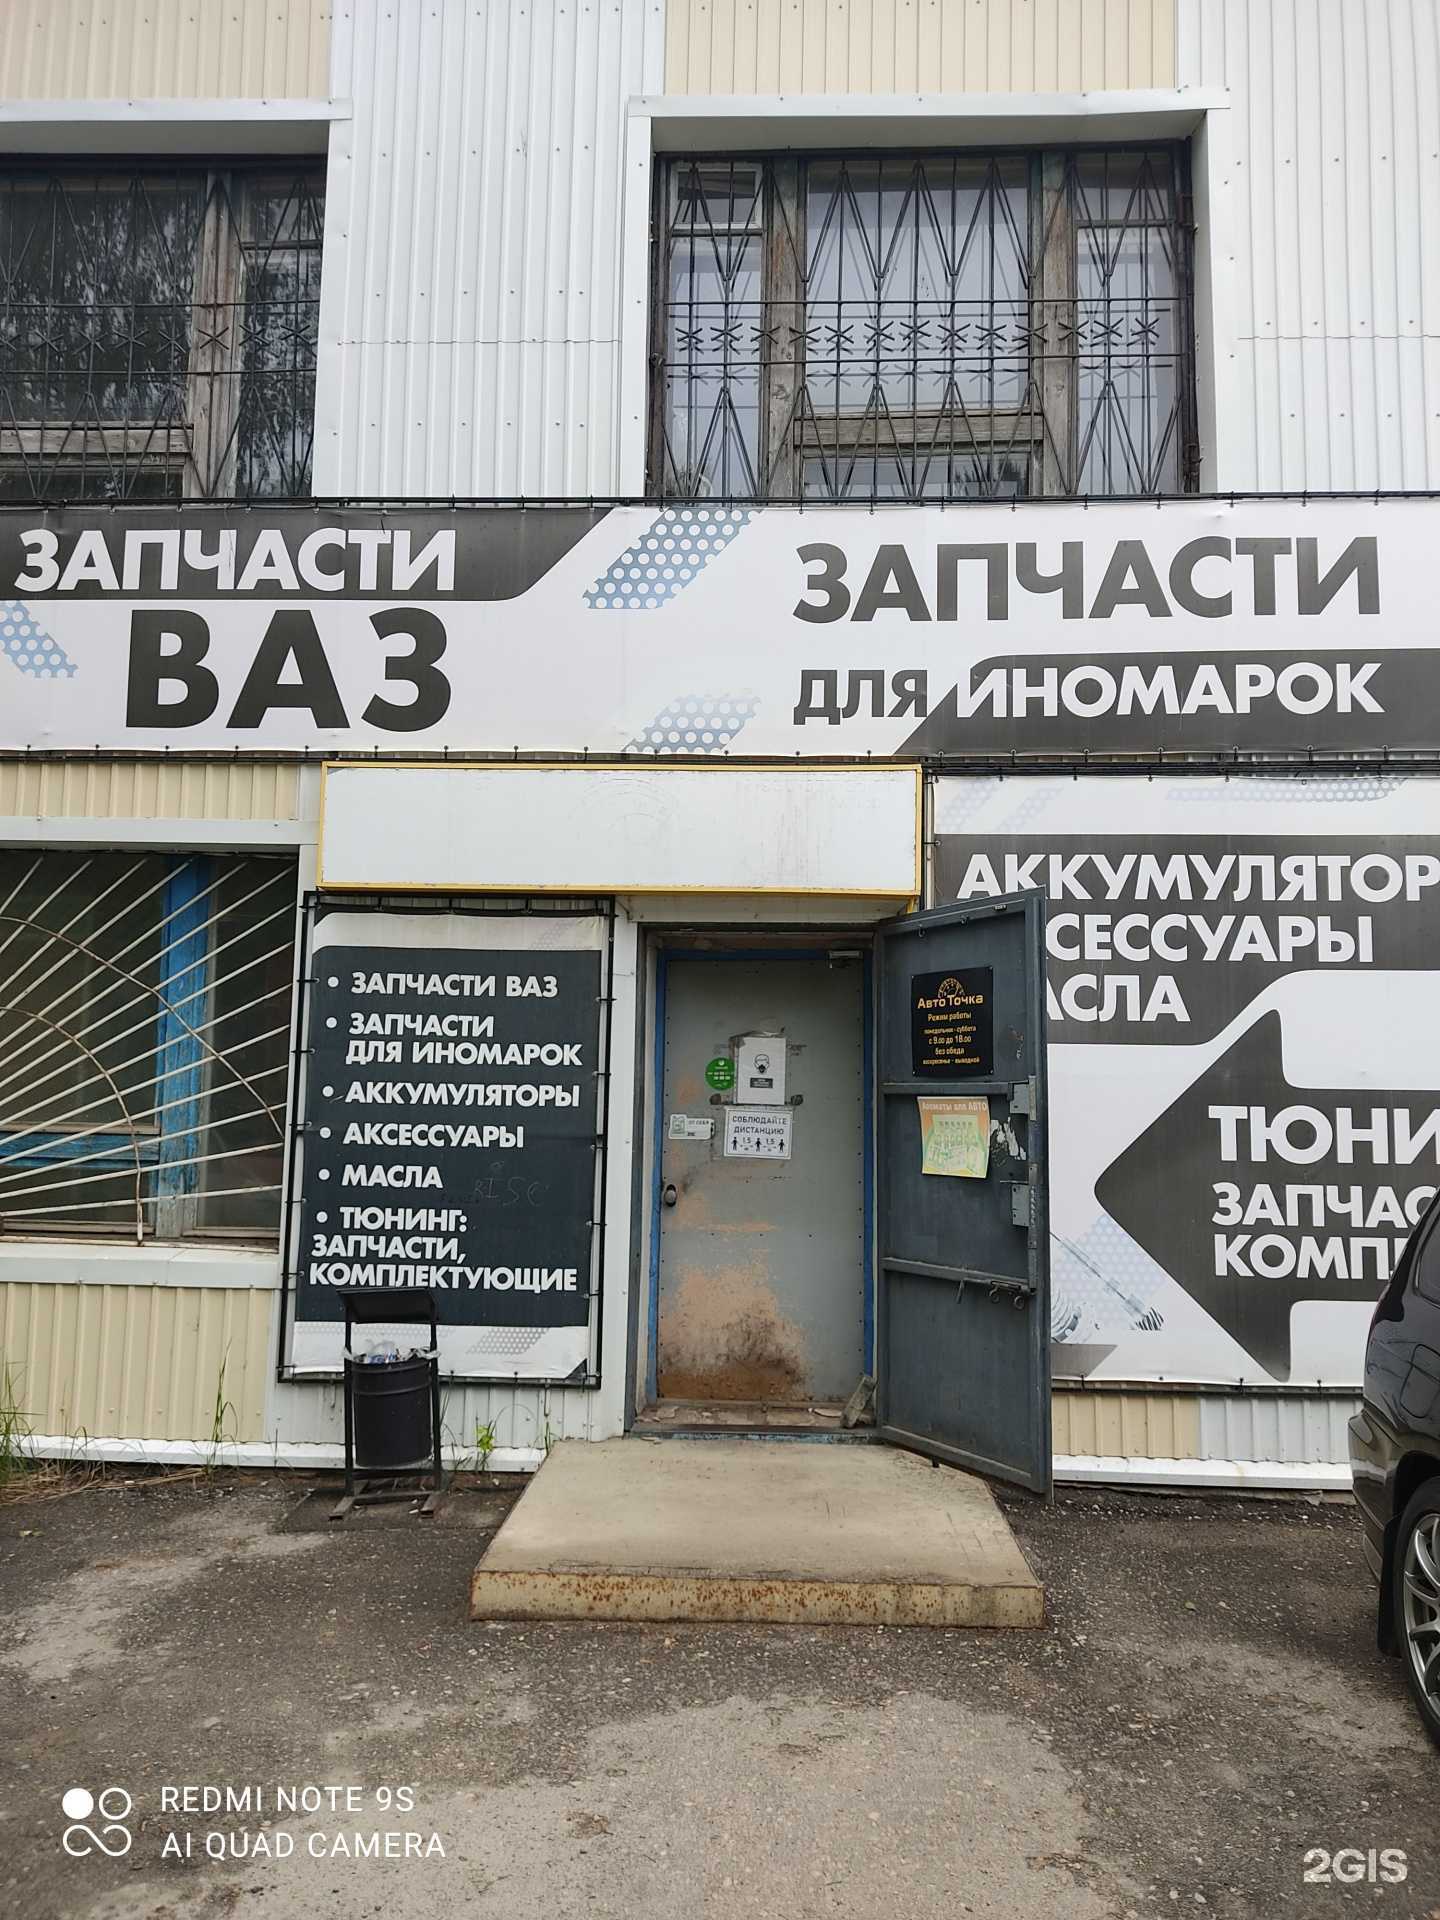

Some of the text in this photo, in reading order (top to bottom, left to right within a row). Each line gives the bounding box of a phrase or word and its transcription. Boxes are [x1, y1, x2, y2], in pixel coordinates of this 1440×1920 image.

[14, 527, 456, 593] ЗАПЧАСТИ
[793, 536, 1380, 624] ЗАПЧАСТИ
[126, 607, 452, 732] ВАЗ
[793, 662, 1385, 725] ДЛЯ ИНОМАРОК
[957, 853, 1440, 902] АККУМУЛЯТОР
[1046, 913, 1373, 962] СЕССУАРЫ
[351, 972, 558, 998] ЗАПЧАСТИ ВАЗ
[349, 1013, 494, 1038] ЗАПЧАСТИ
[345, 1040, 583, 1067] ДЛЯ ИНОМАРОК
[345, 1082, 580, 1107] АККУМУЛЯТОРЫ
[732, 1115, 788, 1126] СОБЛЮДАЙТЕ
[733, 1126, 785, 1136] ДИСТАНЦИЮ
[343, 1122, 524, 1148] АКСЕССУАРЫ
[1208, 1105, 1440, 1166] ТЮНИ
[341, 1164, 443, 1189] МАСЛА
[340, 1206, 468, 1233] ТЮНИНГ:
[312, 1234, 466, 1264] ЗАПЧАСТИ,
[310, 1262, 577, 1293] КОМПЛЕКТУЮЩИЕ
